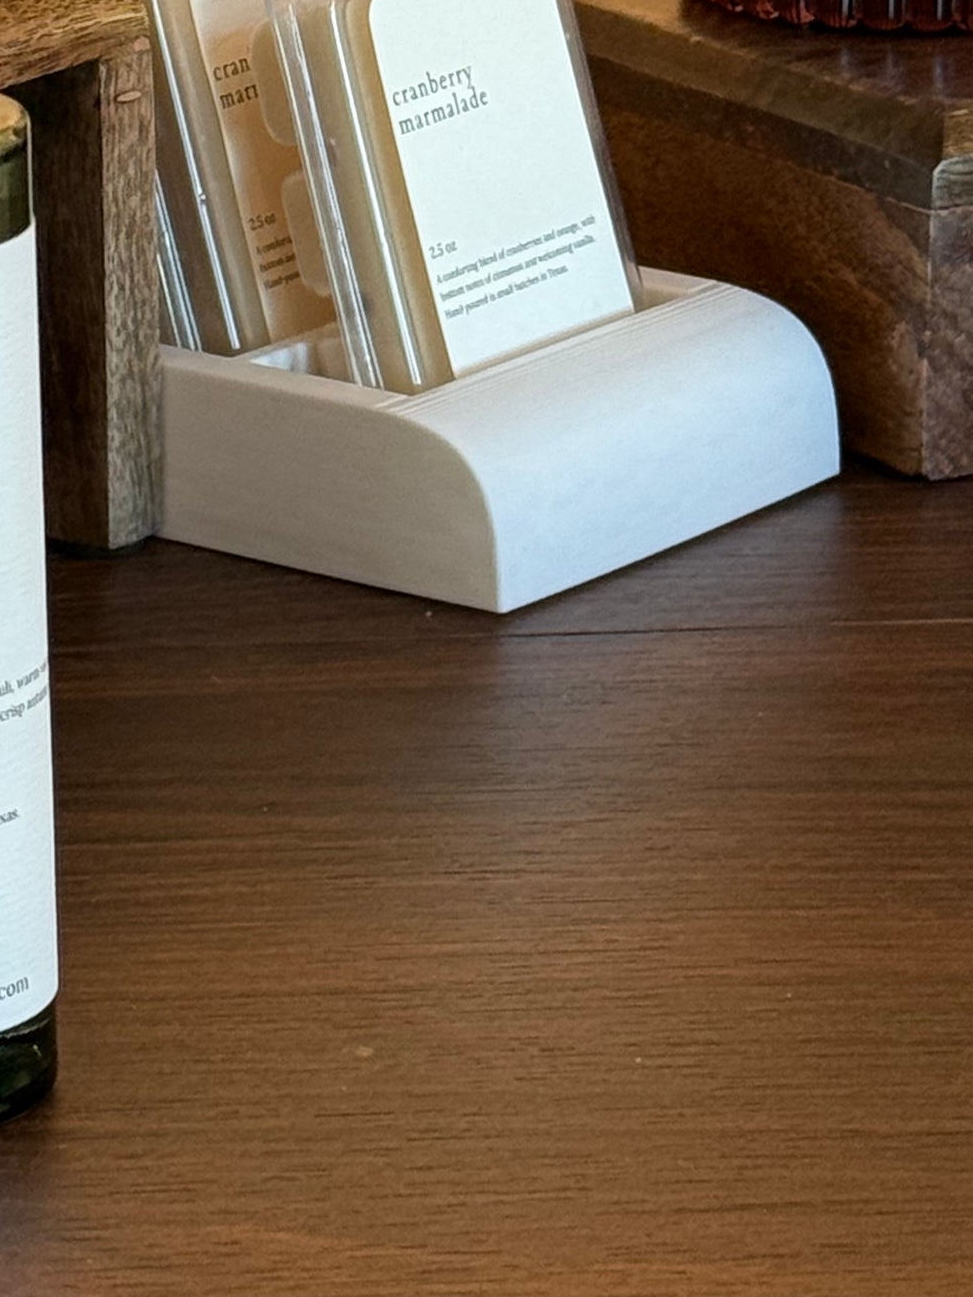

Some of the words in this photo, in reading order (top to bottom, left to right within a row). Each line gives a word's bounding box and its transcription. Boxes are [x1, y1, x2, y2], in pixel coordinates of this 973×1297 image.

[392, 66, 472, 106] cranberry
[398, 85, 488, 135] marmalade
[445, 241, 457, 254] oz
[498, 248, 505, 260] of
[0, 704, 25, 722] crisp
